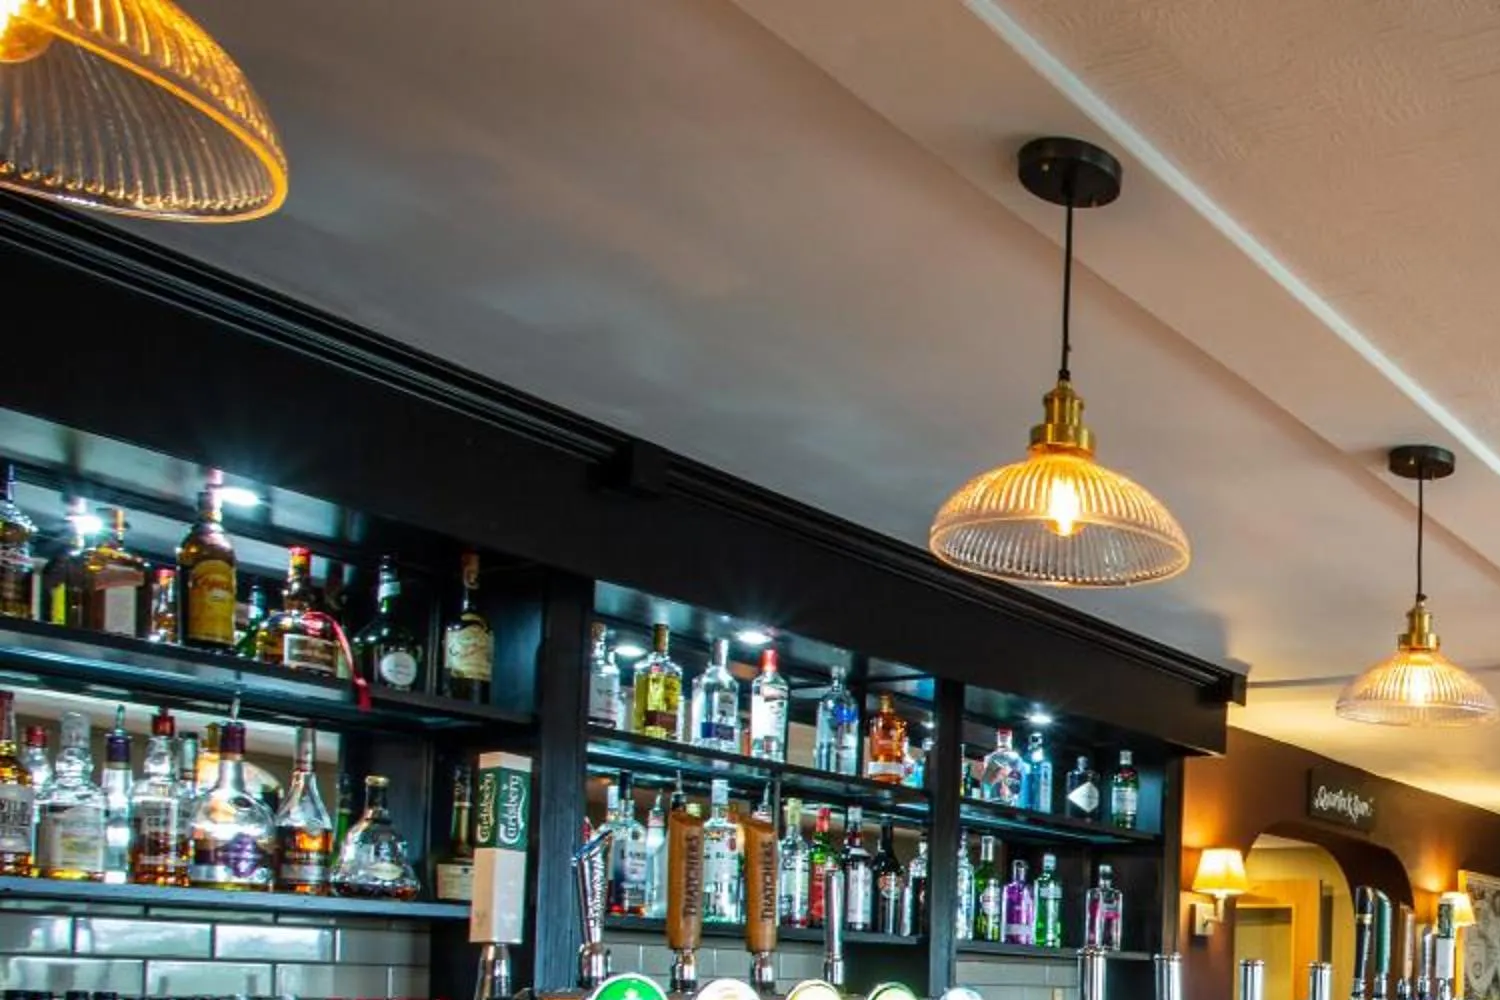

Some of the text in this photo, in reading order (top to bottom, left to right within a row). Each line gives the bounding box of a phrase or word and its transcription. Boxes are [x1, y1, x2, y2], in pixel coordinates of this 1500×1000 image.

[500, 775, 526, 844] Carlsberg
[684, 833, 699, 916] THATCHERS
[760, 841, 773, 922] THATCHERS
